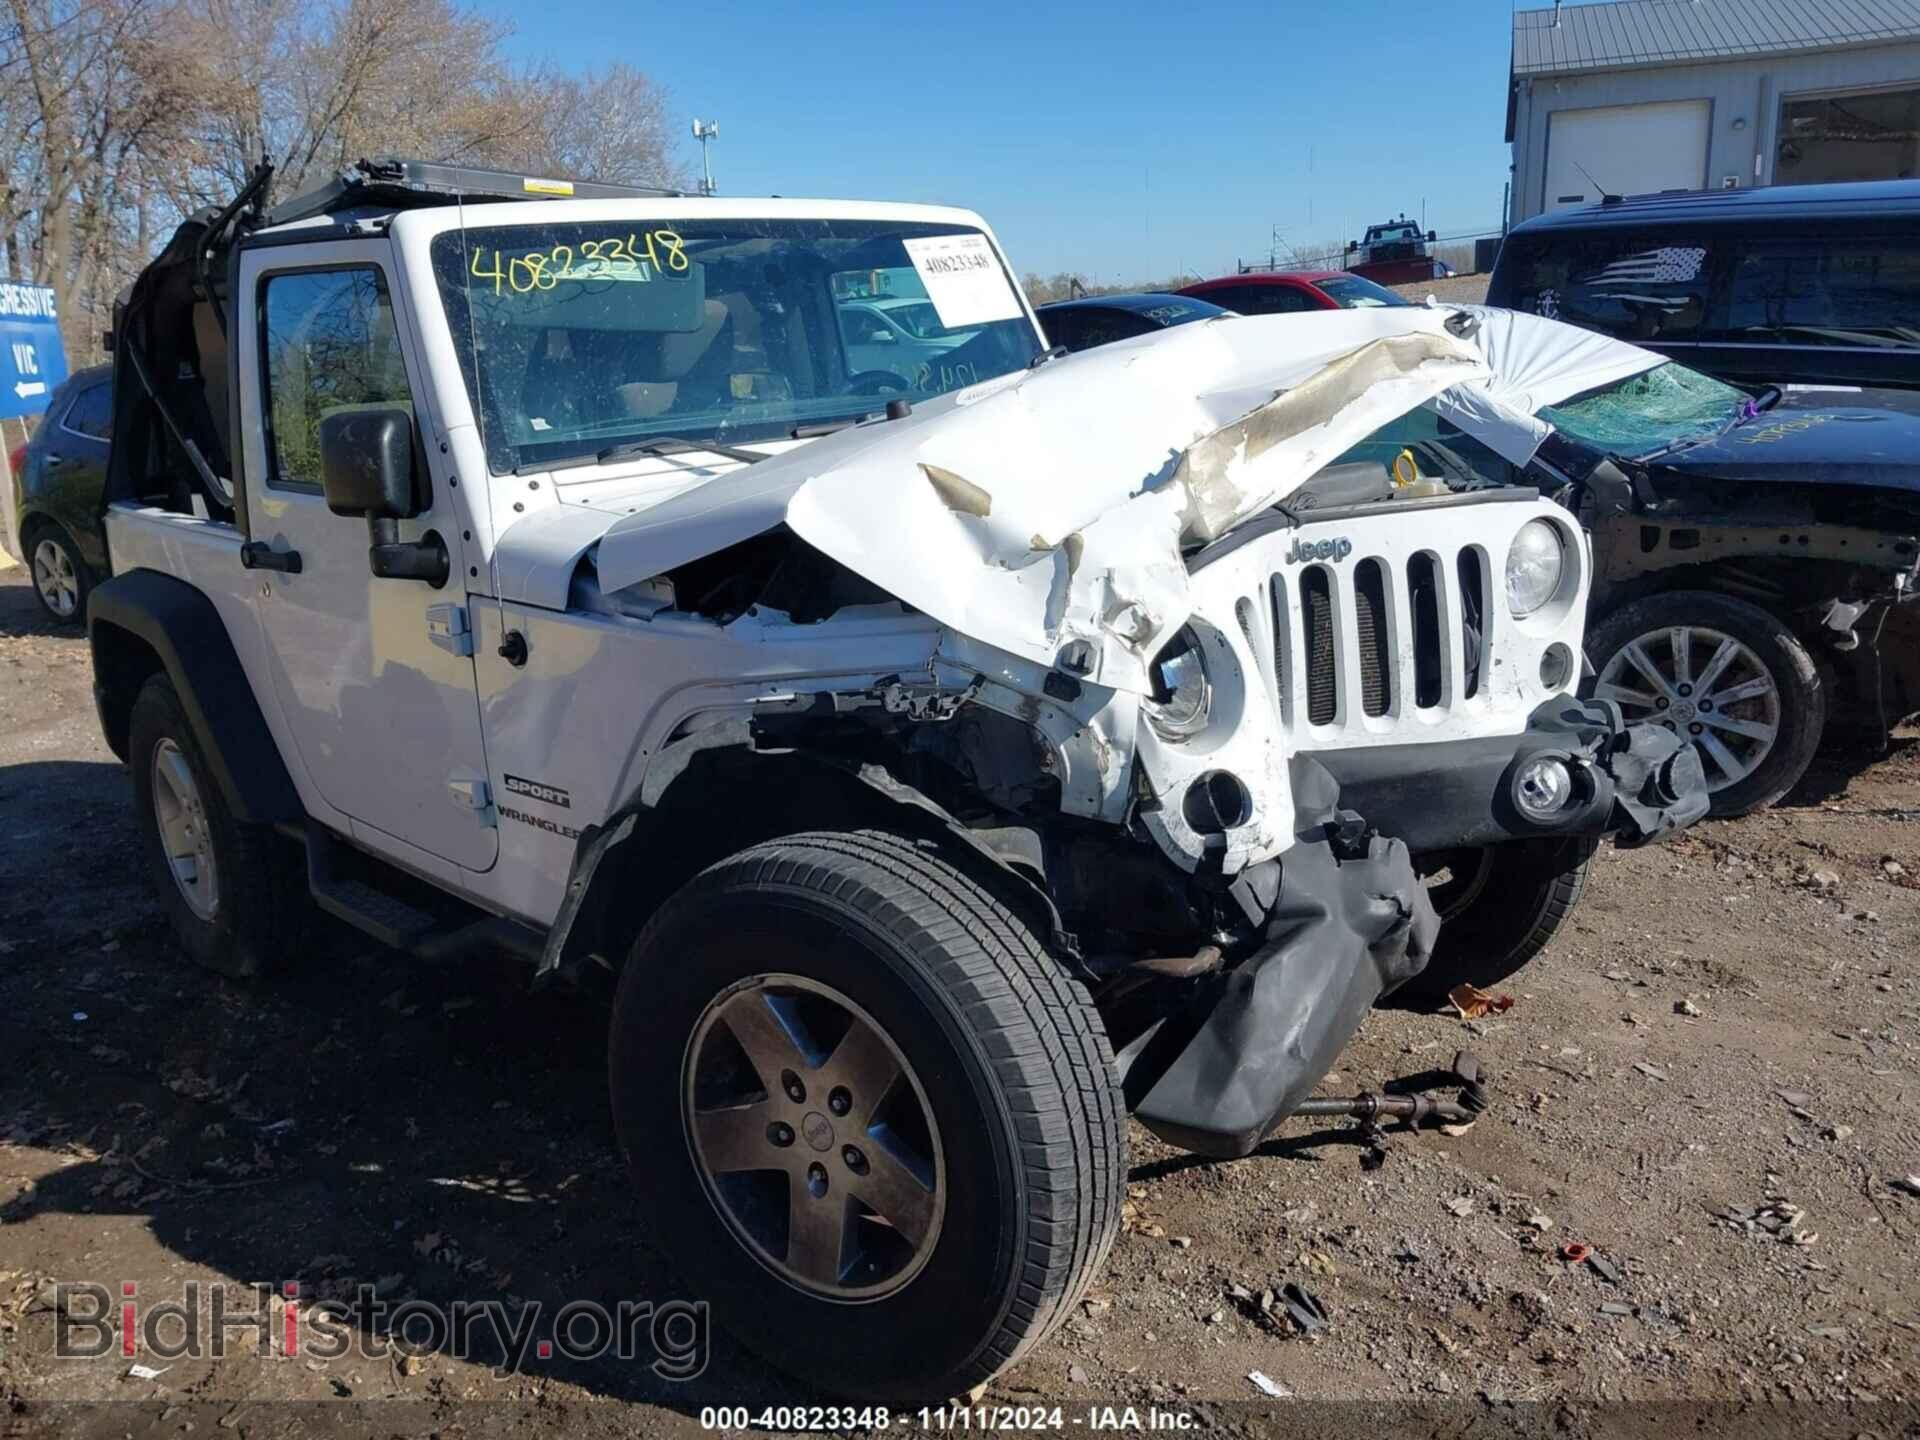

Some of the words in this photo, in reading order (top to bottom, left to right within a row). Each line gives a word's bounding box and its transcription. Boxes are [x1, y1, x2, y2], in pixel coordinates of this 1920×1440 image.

[471, 230, 688, 296] 40823348
[925, 254, 990, 274] 40823348
[1286, 536, 1352, 565] Jeep
[506, 776, 568, 806] SPORT
